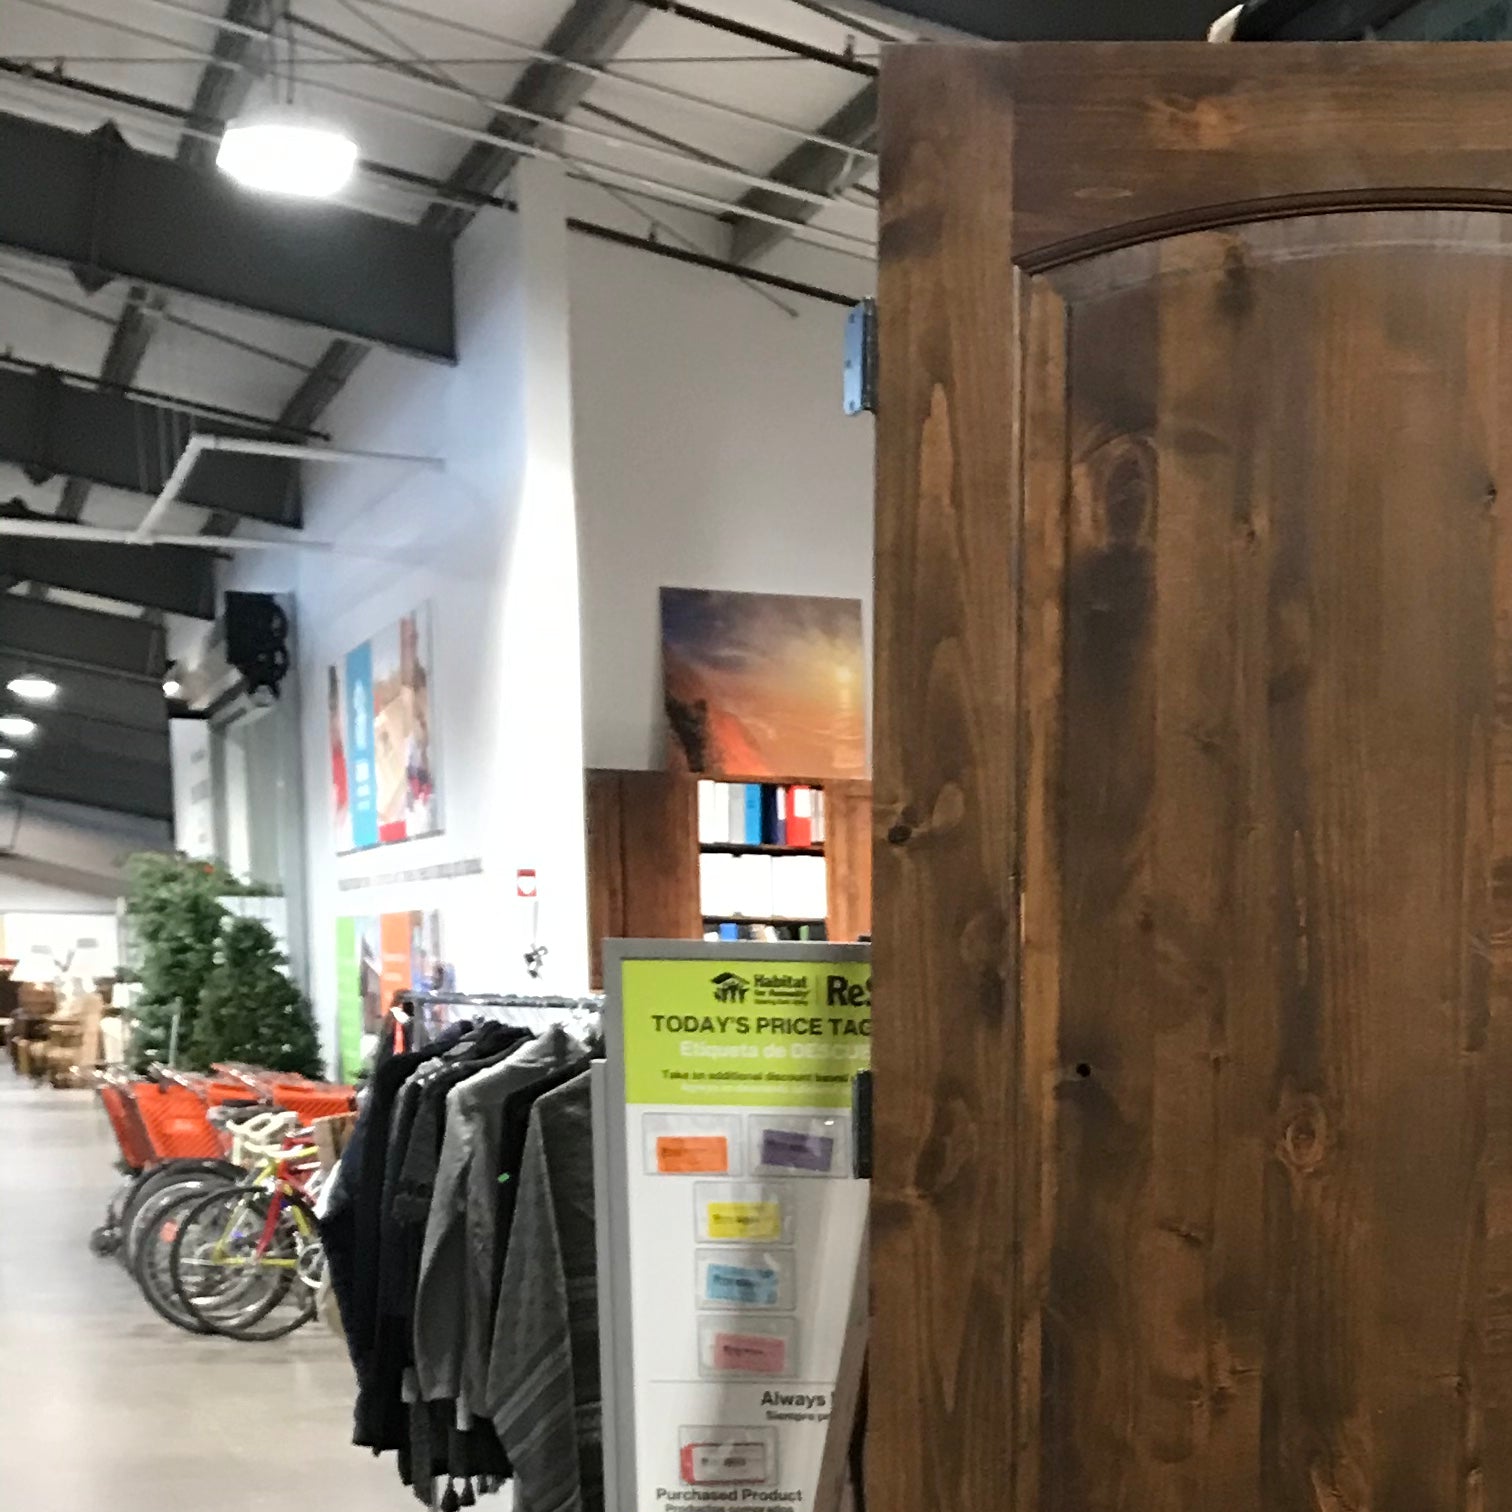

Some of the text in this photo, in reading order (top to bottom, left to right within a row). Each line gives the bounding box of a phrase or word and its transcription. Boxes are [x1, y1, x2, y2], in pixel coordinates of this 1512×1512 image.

[651, 1014, 750, 1034] TODAY'S
[756, 1017, 823, 1035] PRICE
[761, 1390, 826, 1409] Always
[656, 1487, 802, 1502] Purchased Product
